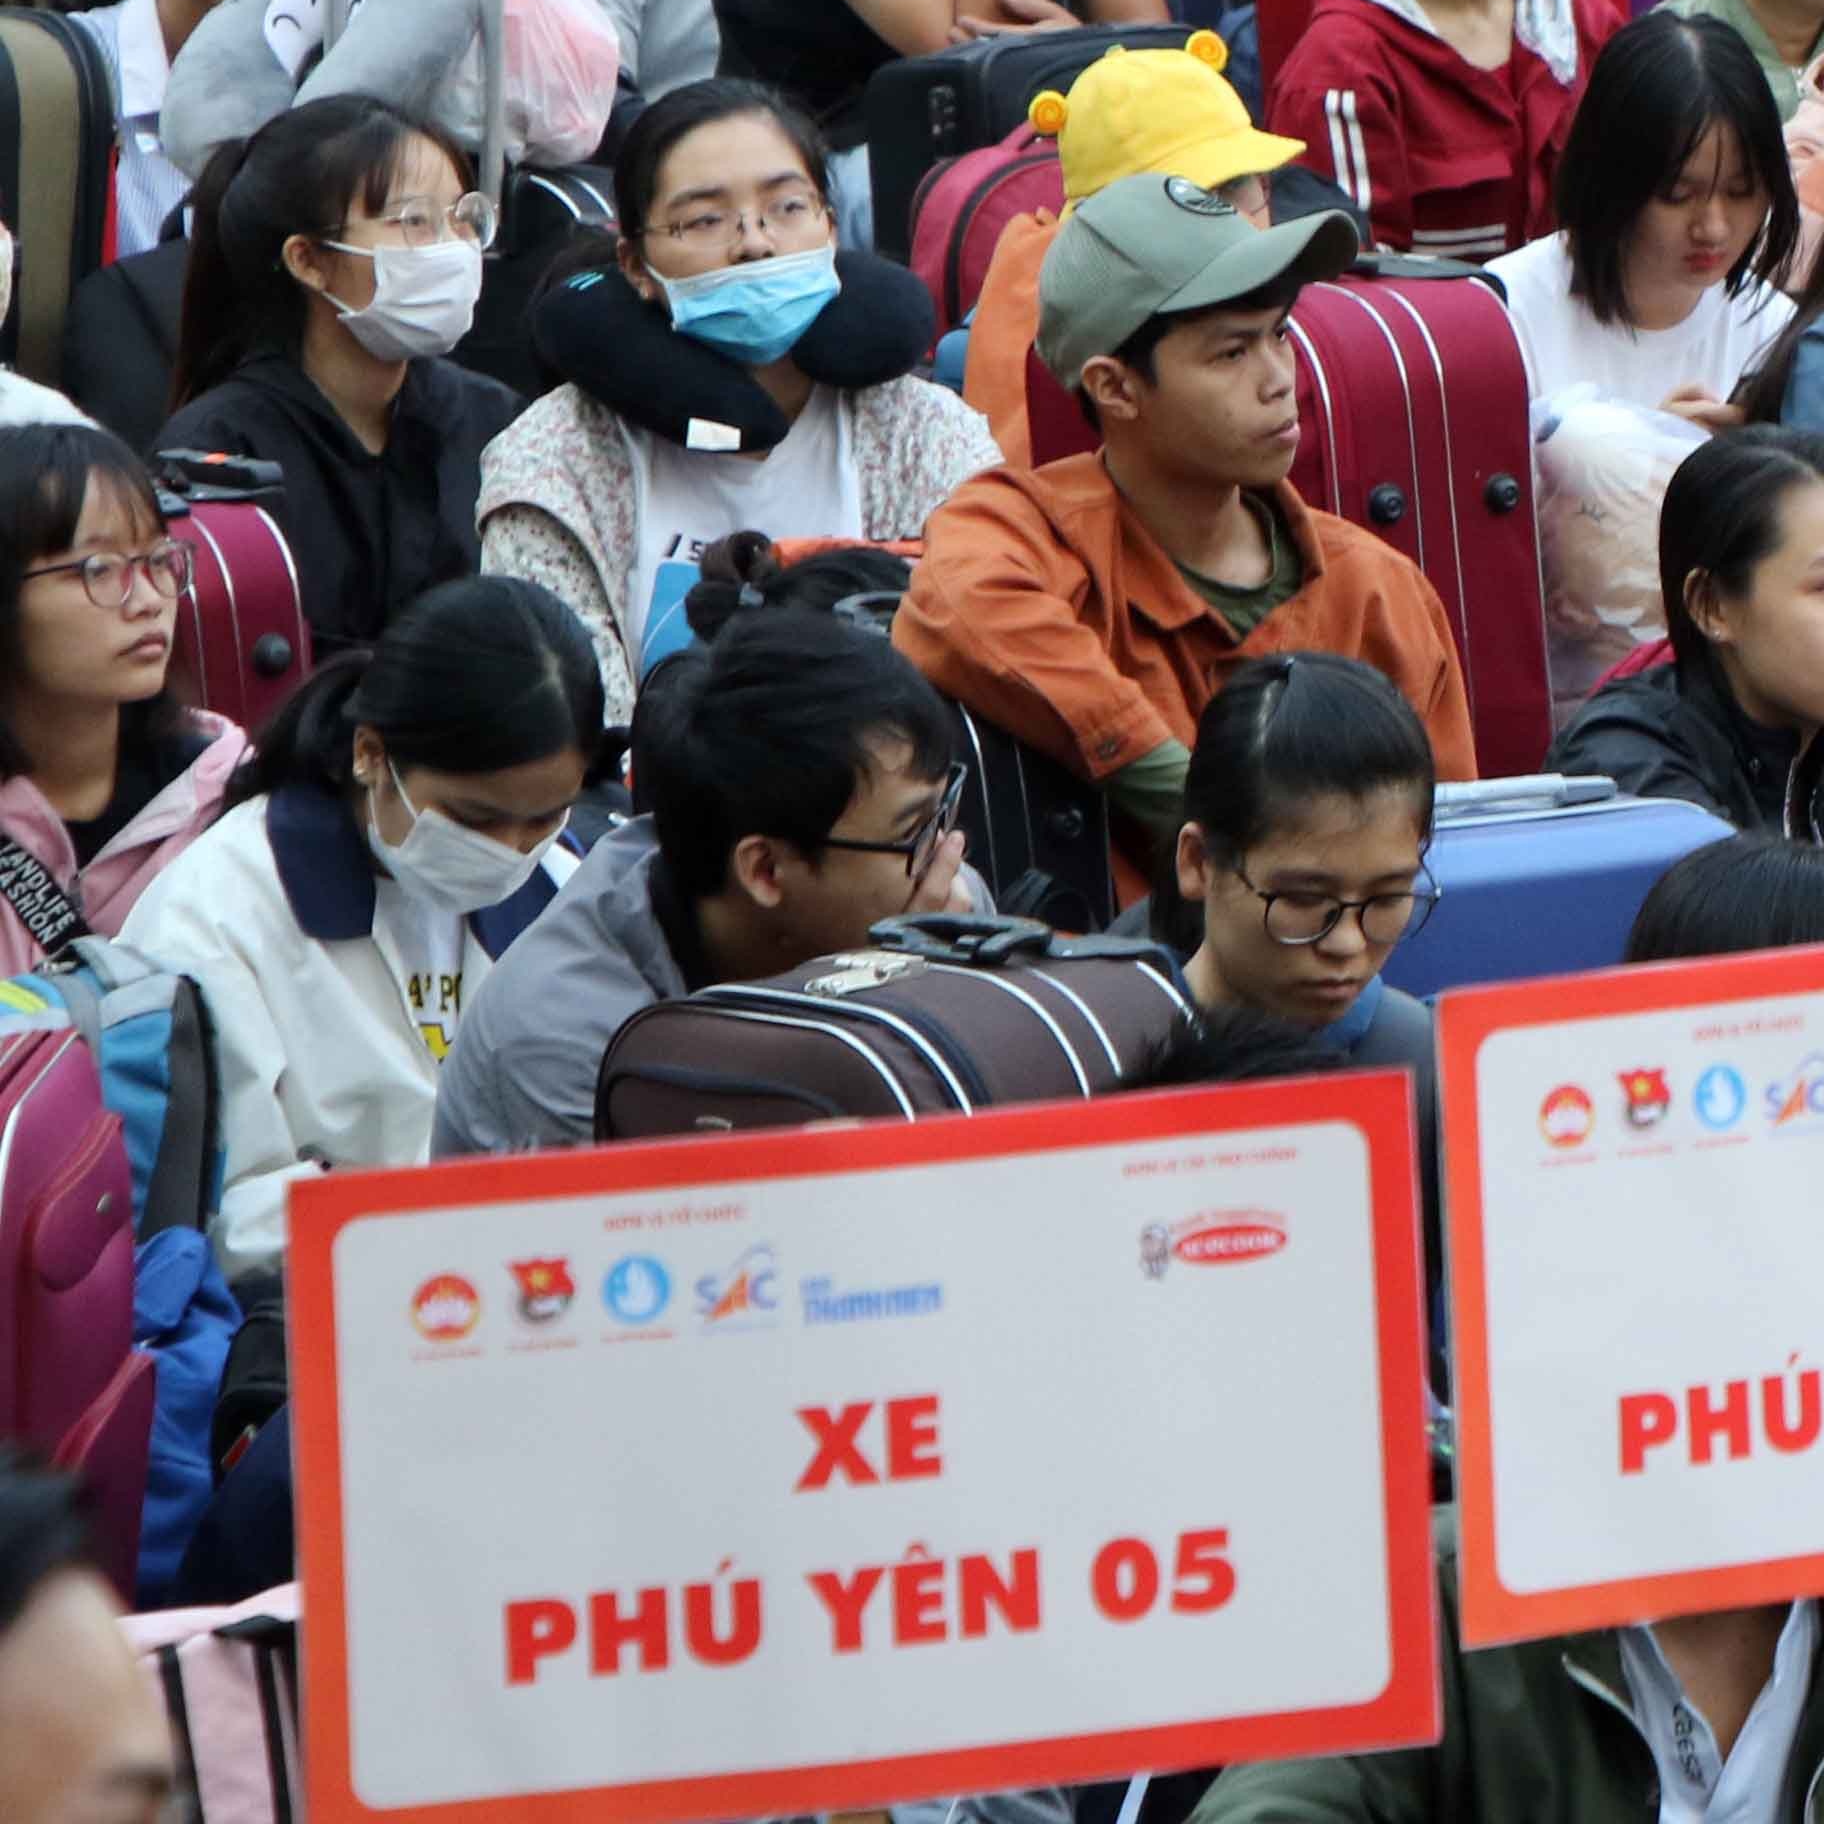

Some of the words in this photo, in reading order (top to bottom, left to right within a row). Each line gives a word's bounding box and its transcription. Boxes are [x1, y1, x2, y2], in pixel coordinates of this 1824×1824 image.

[793, 1395, 943, 1493] XE
[1618, 1351, 1823, 1476] PHÚ
[504, 1556, 764, 1687] PHÚ
[803, 1542, 1041, 1654] YÊN
[1089, 1528, 1238, 1625] 05
